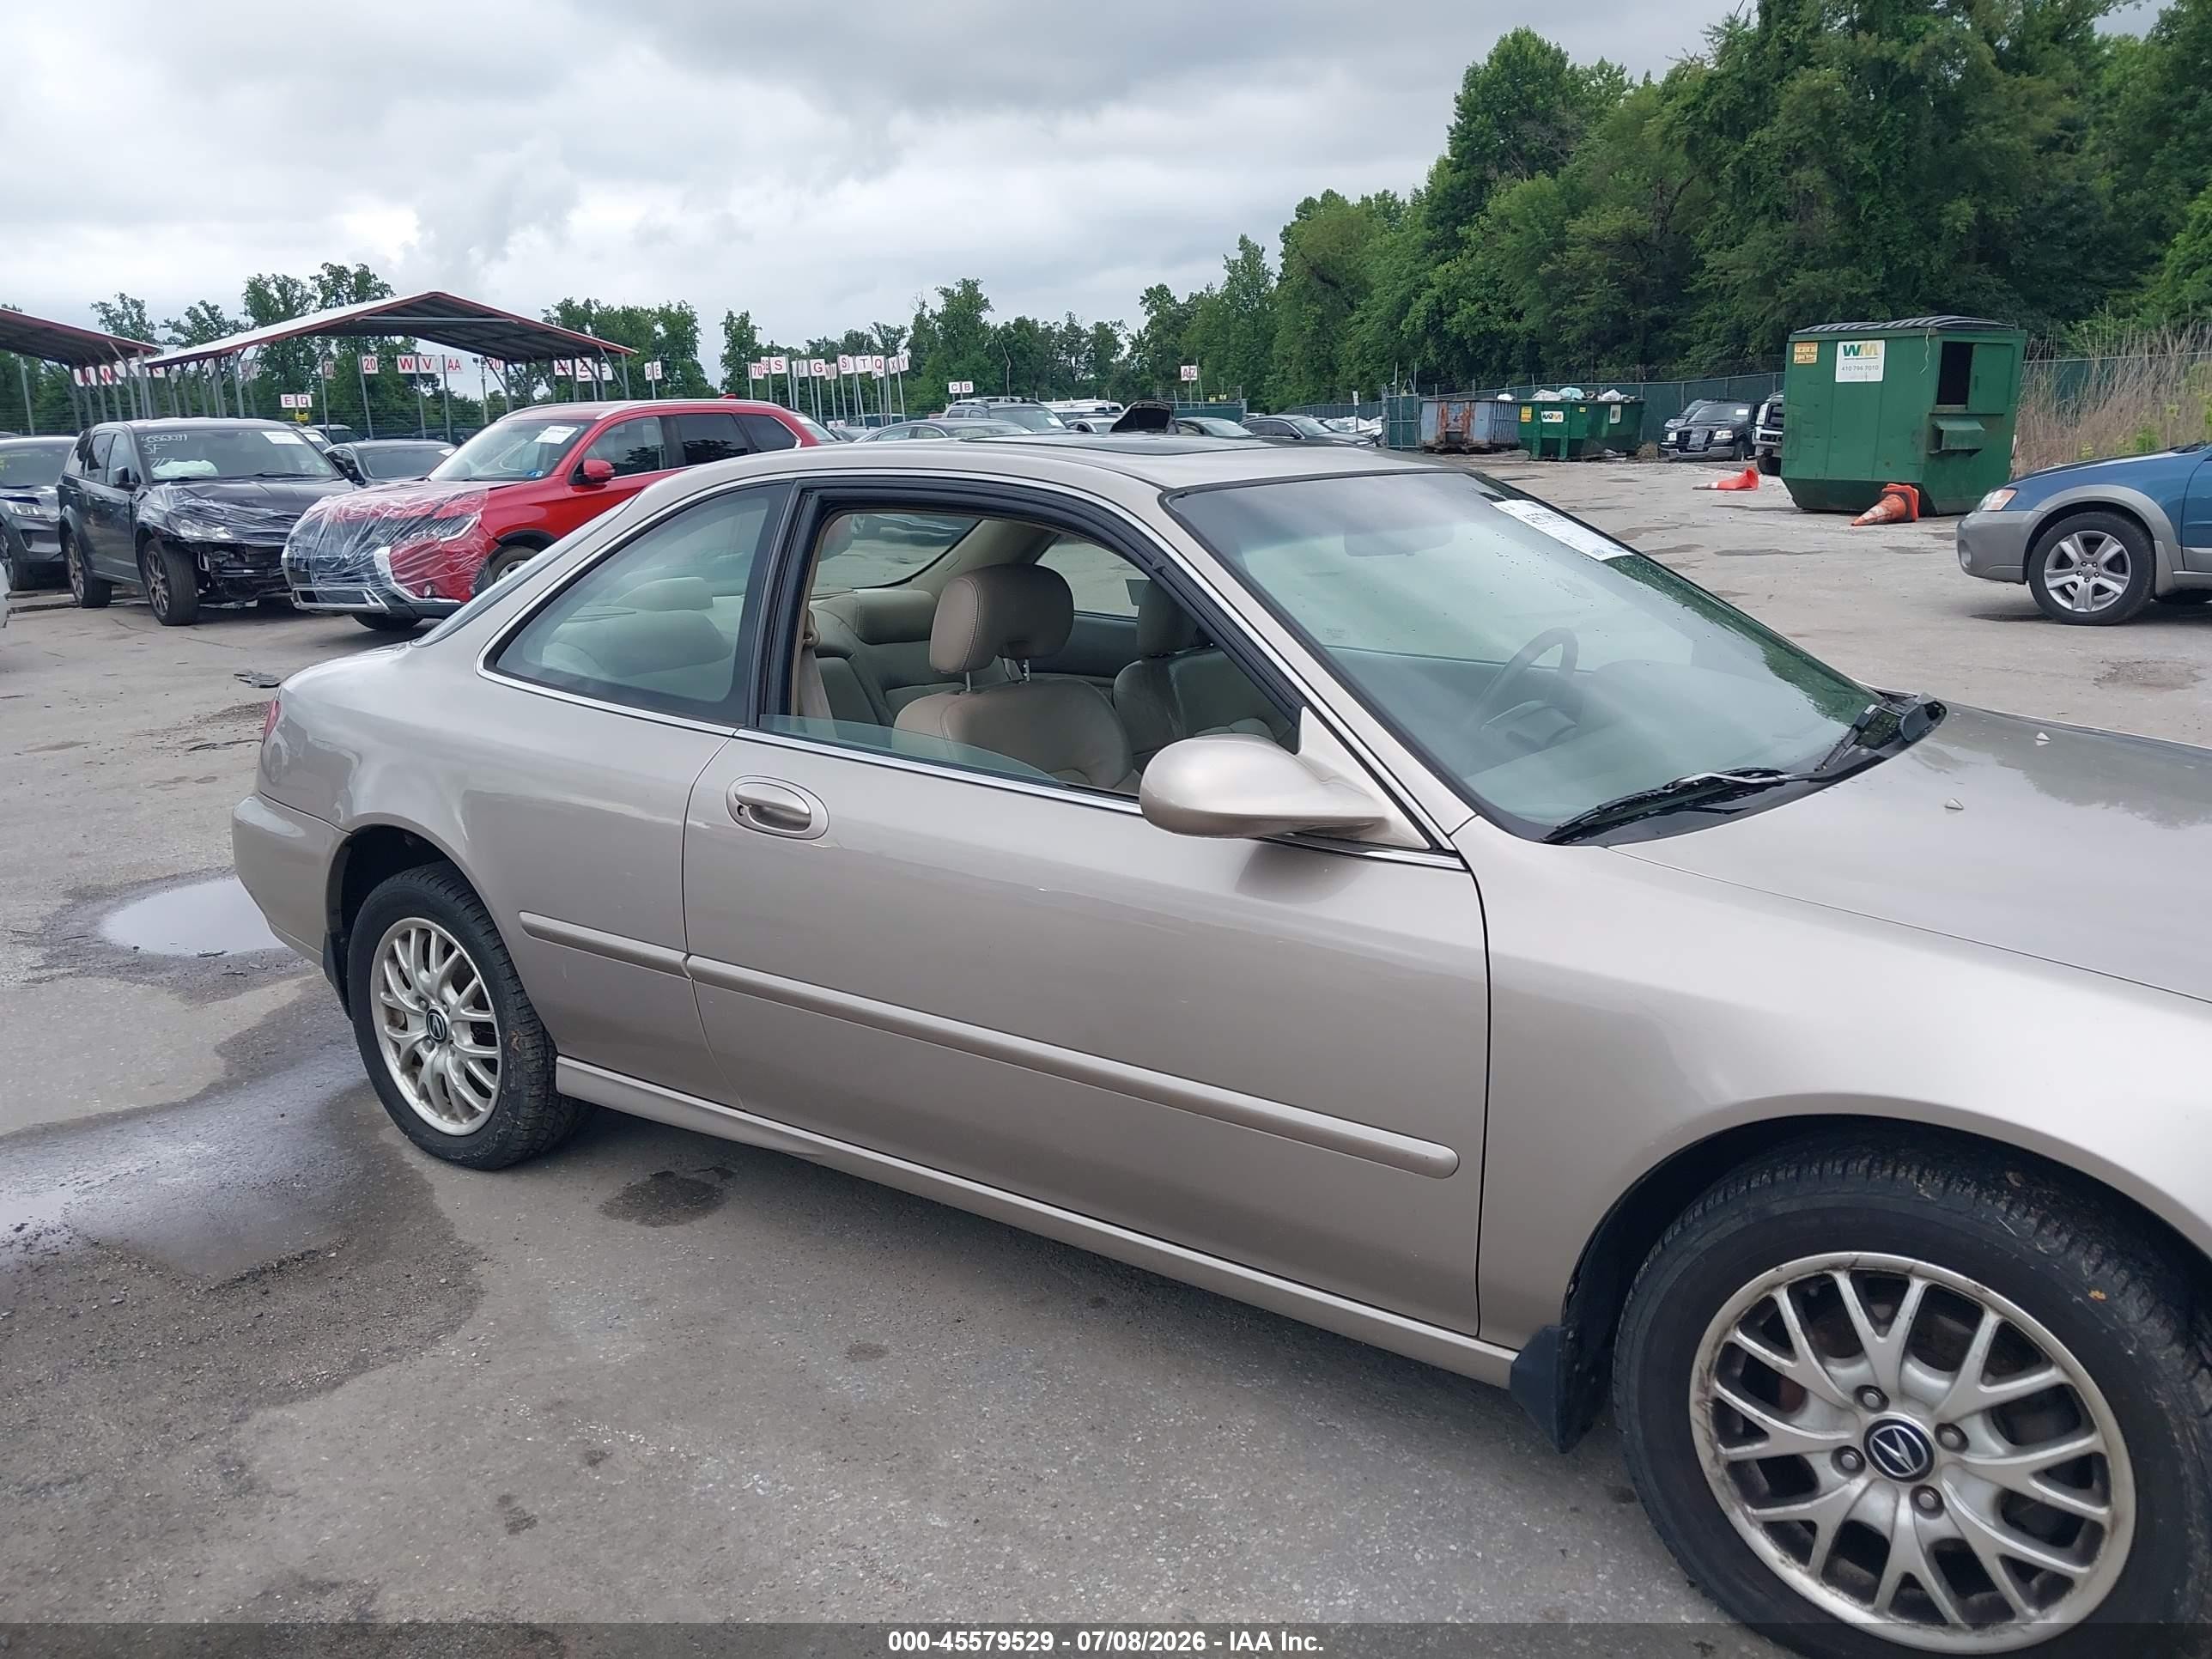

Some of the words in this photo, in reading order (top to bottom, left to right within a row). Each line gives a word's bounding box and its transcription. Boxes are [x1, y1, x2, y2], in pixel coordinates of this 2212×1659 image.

[1843, 344, 1878, 356] WM
[363, 357, 376, 370] 20
[398, 357, 413, 370] W
[422, 358, 432, 370] V
[447, 360, 461, 370] AA
[775, 360, 783, 371] S
[813, 362, 823, 373] G
[842, 357, 847, 368] S
[860, 358, 867, 368] T
[874, 358, 883, 369] Q
[900, 357, 906, 367] Y
[646, 366, 652, 376] D
[655, 365, 660, 375] E
[752, 365, 763, 376] 70
[964, 383, 971, 392] B
[284, 396, 293, 405] E
